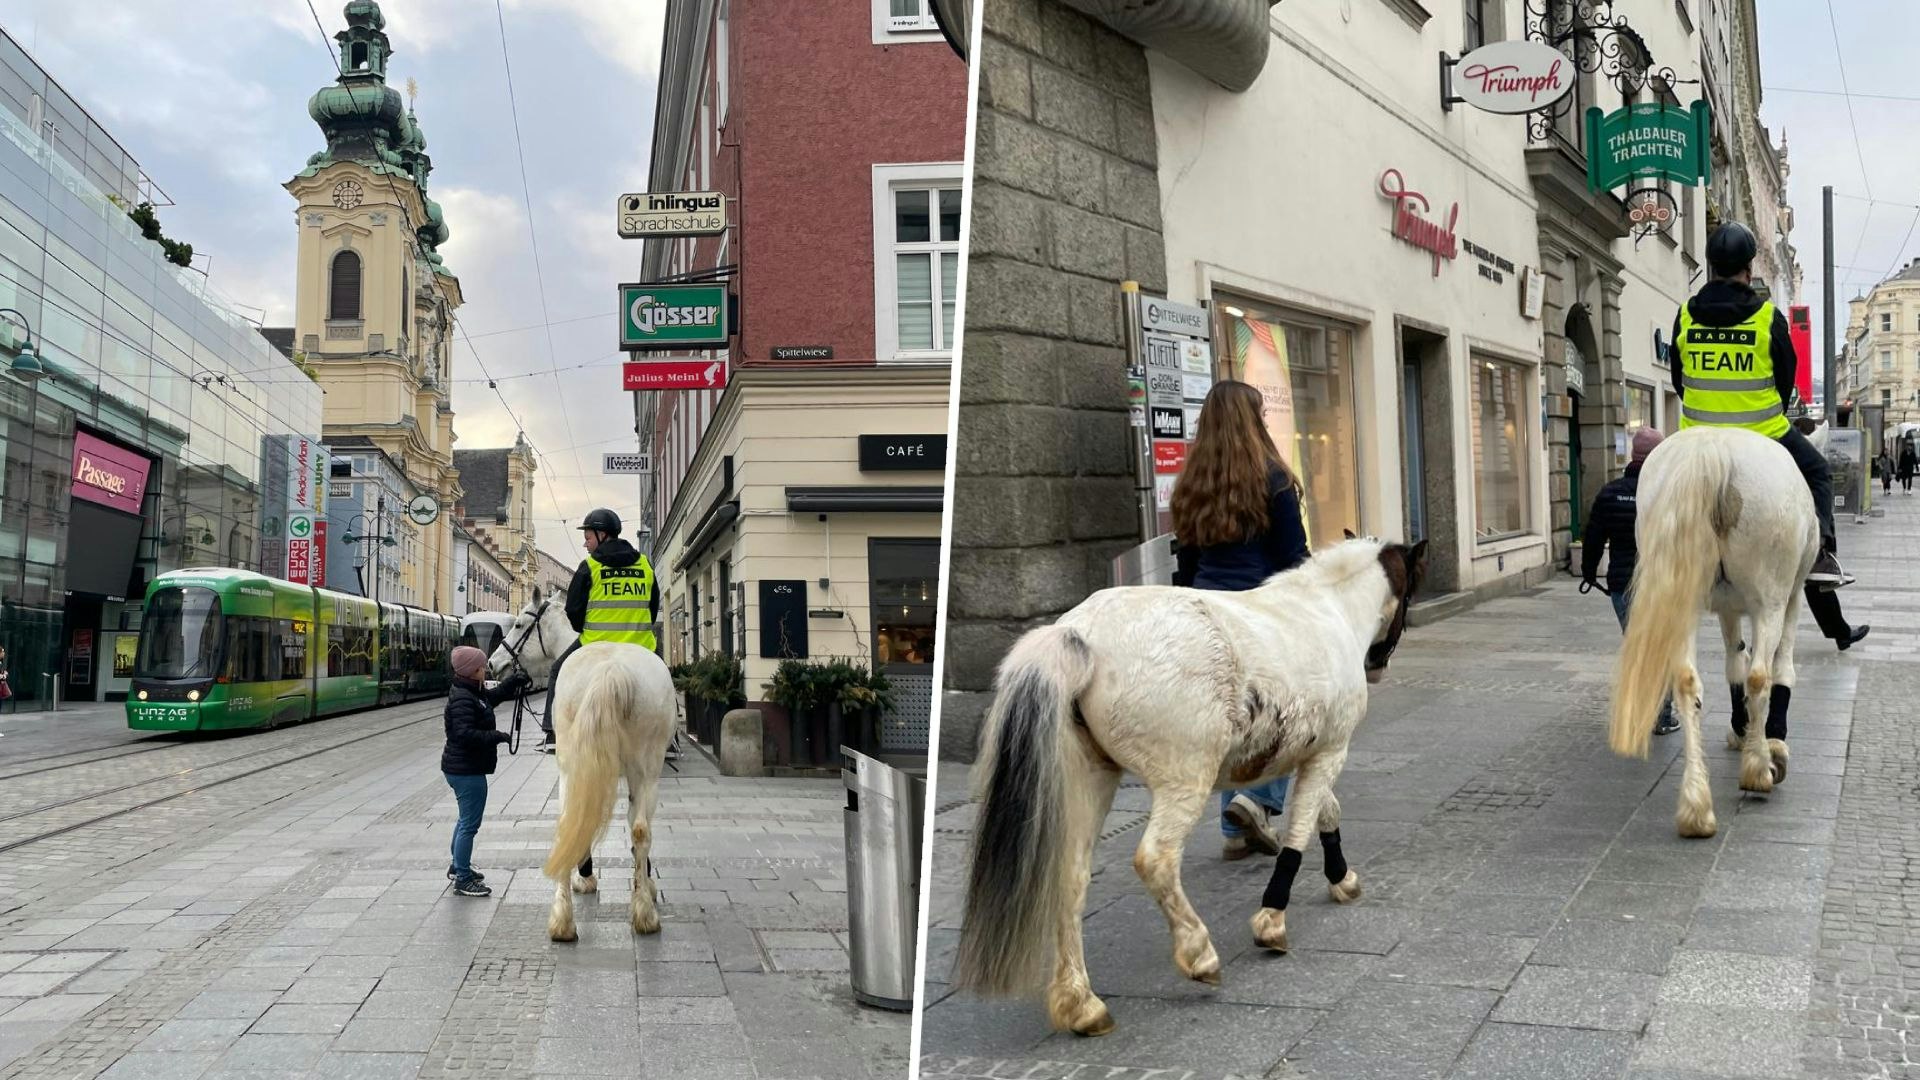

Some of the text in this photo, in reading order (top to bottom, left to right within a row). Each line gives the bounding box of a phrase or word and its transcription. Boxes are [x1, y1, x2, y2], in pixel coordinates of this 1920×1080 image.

[1463, 59, 1562, 102] Triumph
[1607, 127, 1687, 150] THALBAUER
[1612, 142, 1683, 164] TRACHTEN
[649, 195, 720, 212] inlingua
[624, 214, 721, 234] Sprachschule
[1380, 168, 1459, 277] Triumph
[630, 295, 720, 335] Gösser
[1694, 332, 1748, 341] RADIO
[777, 348, 828, 359] Spittelwiese
[1688, 351, 1754, 372] TEAM
[627, 372, 699, 383] Julius Meinl
[886, 443, 924, 457] CAFÉ
[613, 459, 642, 468] Wolford
[75, 456, 126, 498] Passage
[290, 540, 300, 578] EURO
[299, 540, 308, 578] SPAR
[601, 582, 646, 596] TEAM
[139, 708, 188, 716] LINZ AG
